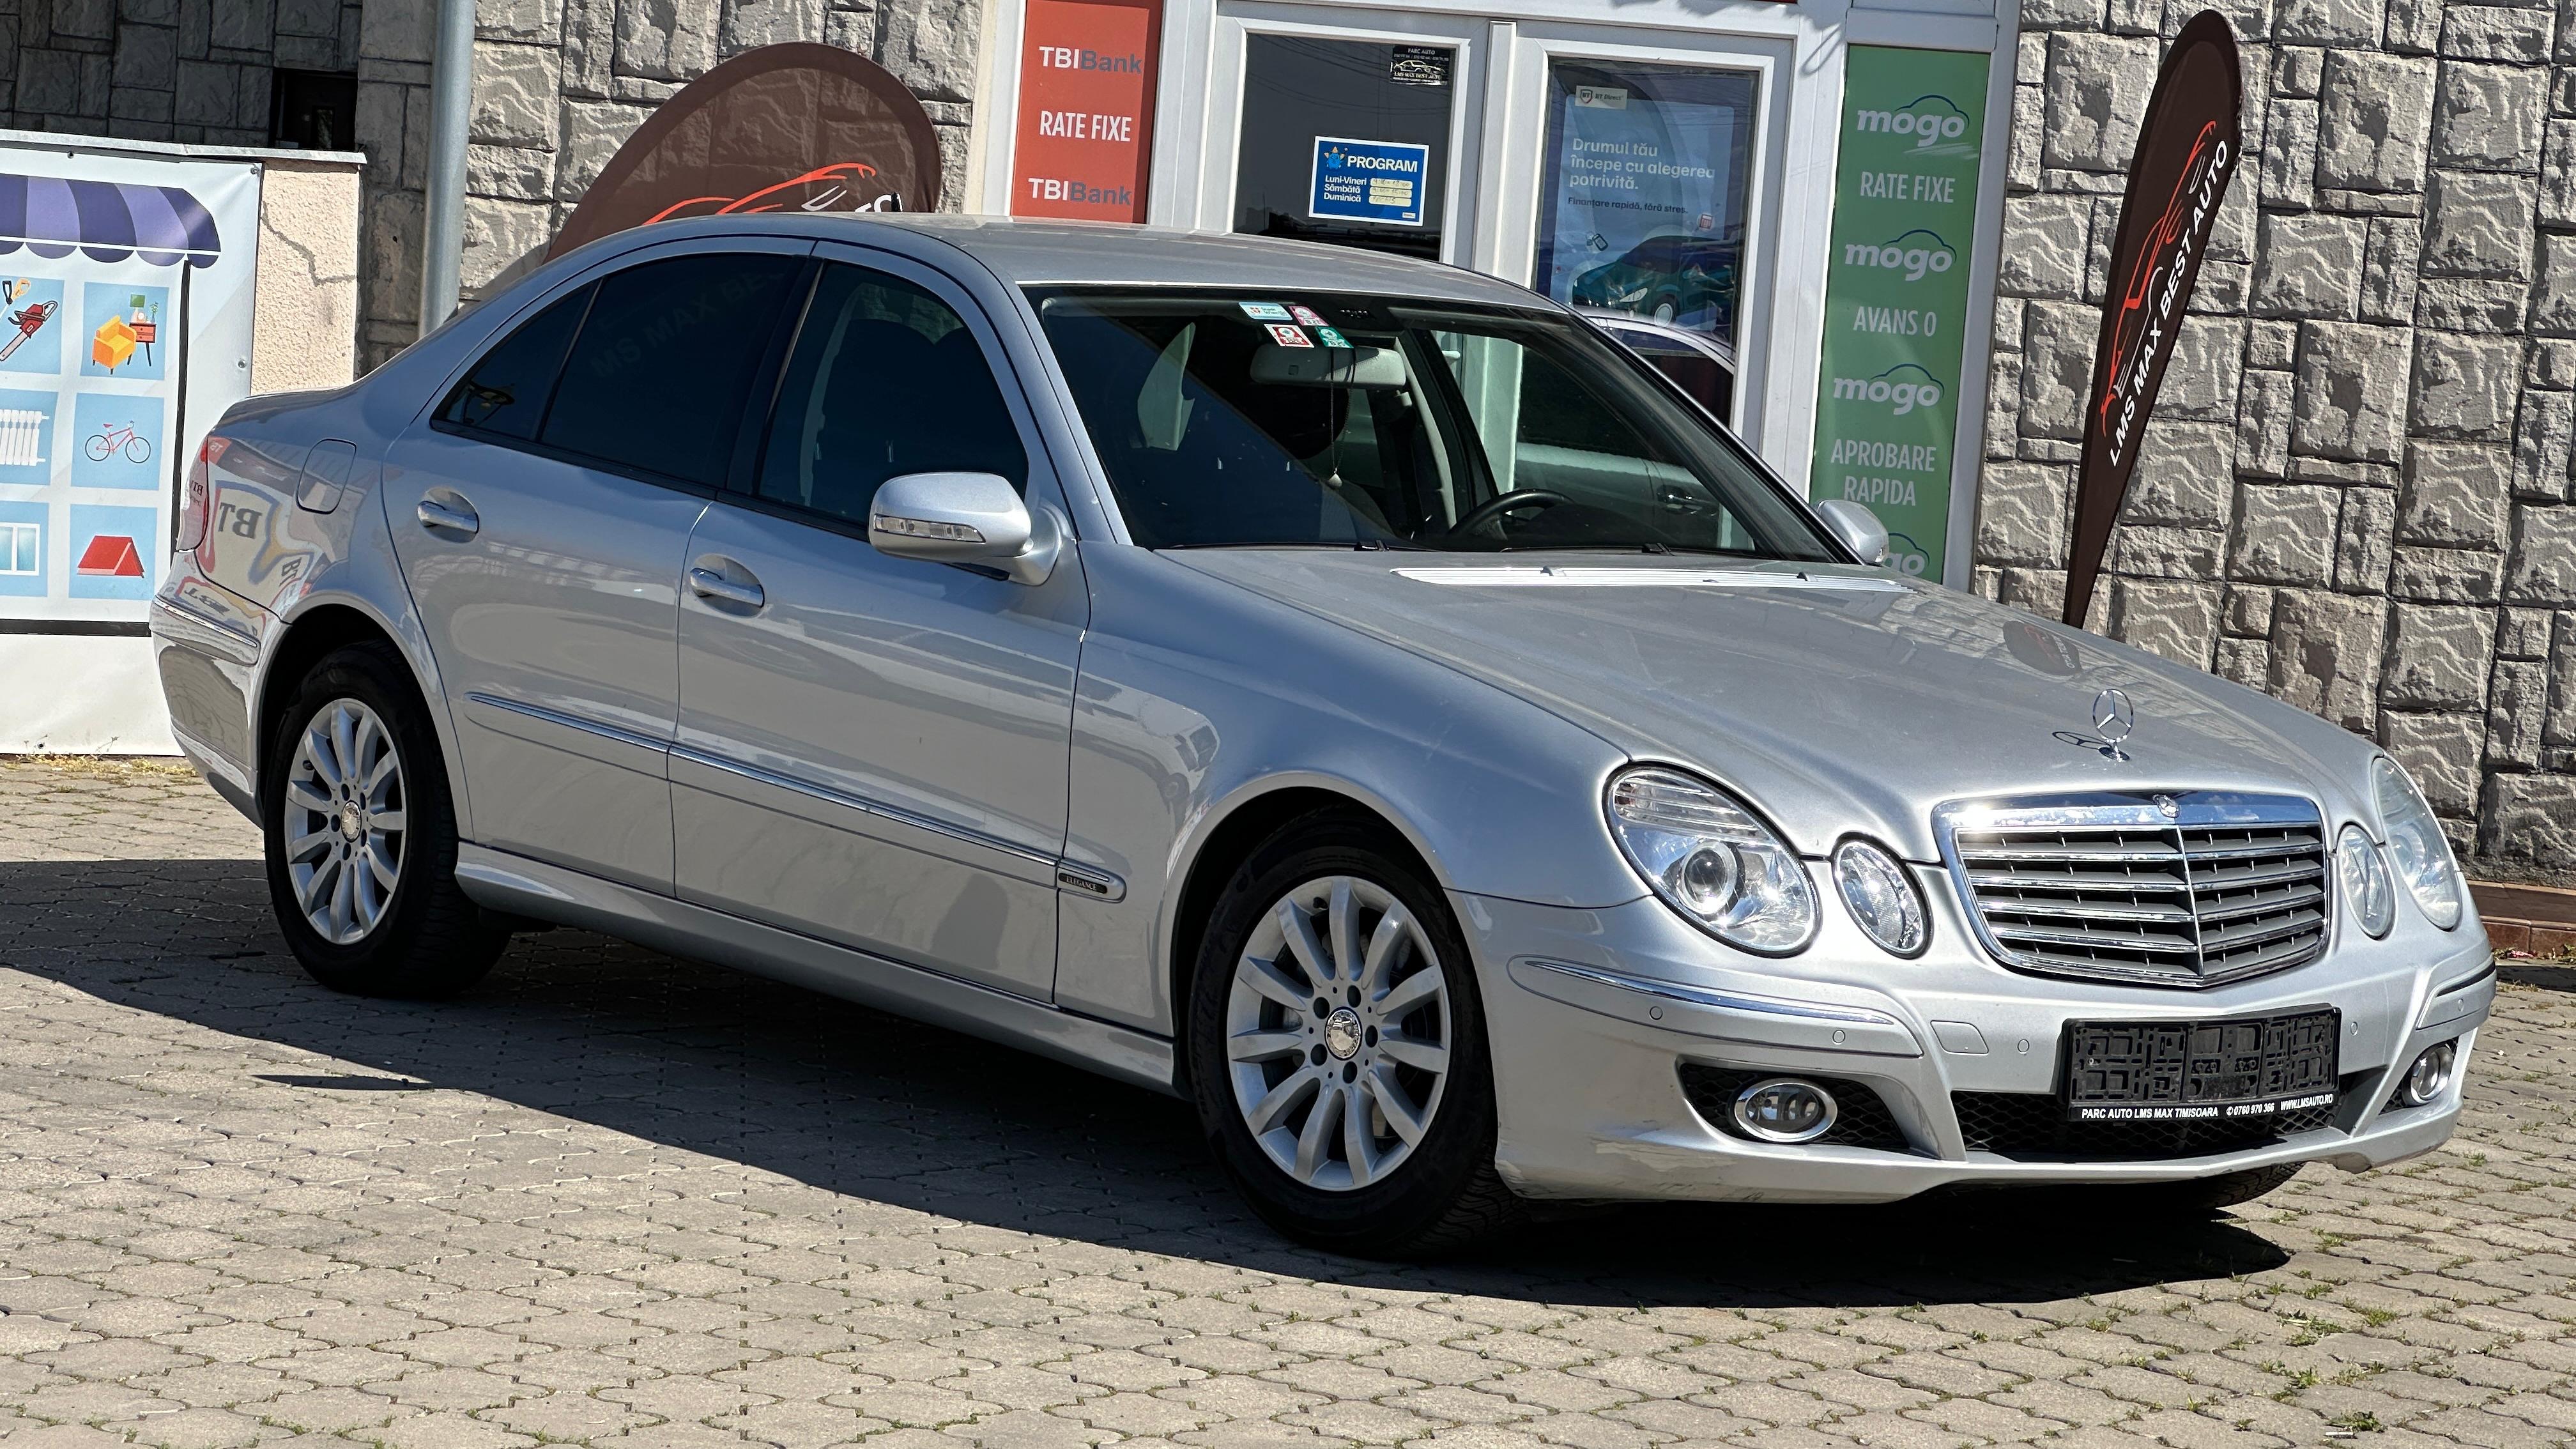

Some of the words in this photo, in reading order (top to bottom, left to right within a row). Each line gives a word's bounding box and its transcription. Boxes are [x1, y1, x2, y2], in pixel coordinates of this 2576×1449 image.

[1039, 45, 1144, 74] TBIBank
[1039, 110, 1087, 139] RATE
[1091, 114, 1132, 142] FIXE
[1857, 109, 1965, 148] mogo
[1572, 137, 1629, 155] Drumul
[1633, 142, 1658, 157] tău
[1347, 155, 1418, 172] PROGRAM
[1570, 154, 1621, 172] începe
[1625, 162, 1644, 173] cu
[1648, 162, 1715, 178] alegerea
[1027, 178, 1132, 205] TBIBank
[1325, 174, 1367, 186] Luni-Vineri
[1569, 173, 1639, 190] potrivită.
[1860, 171, 1909, 199] RATE
[1913, 175, 1956, 203] FIXE
[1844, 243, 1953, 282] mogo
[2110, 394, 2135, 467] LMS
[2133, 317, 2162, 396] MAX
[2159, 227, 2191, 320] BEST
[2193, 139, 2228, 235] AUTO
[1853, 305, 1919, 336] AVANS
[1833, 377, 1940, 415] mogo
[1830, 438, 1936, 472] APROBARE
[1843, 475, 1916, 507] RAPIDA
[1066, 877, 1098, 891] ELEGANCE
[2082, 1108, 2106, 1119] PARC
[2107, 1108, 2133, 1119] AUTO
[2134, 1108, 2152, 1119] LMS
[2154, 1108, 2174, 1118] MAX
[2174, 1107, 2219, 1118] TIMISOARA
[2234, 1105, 2250, 1116] 0760
[2251, 1104, 2263, 1114] 970
[2280, 1093, 2334, 1111] WWW.LMSAUTO.RO
